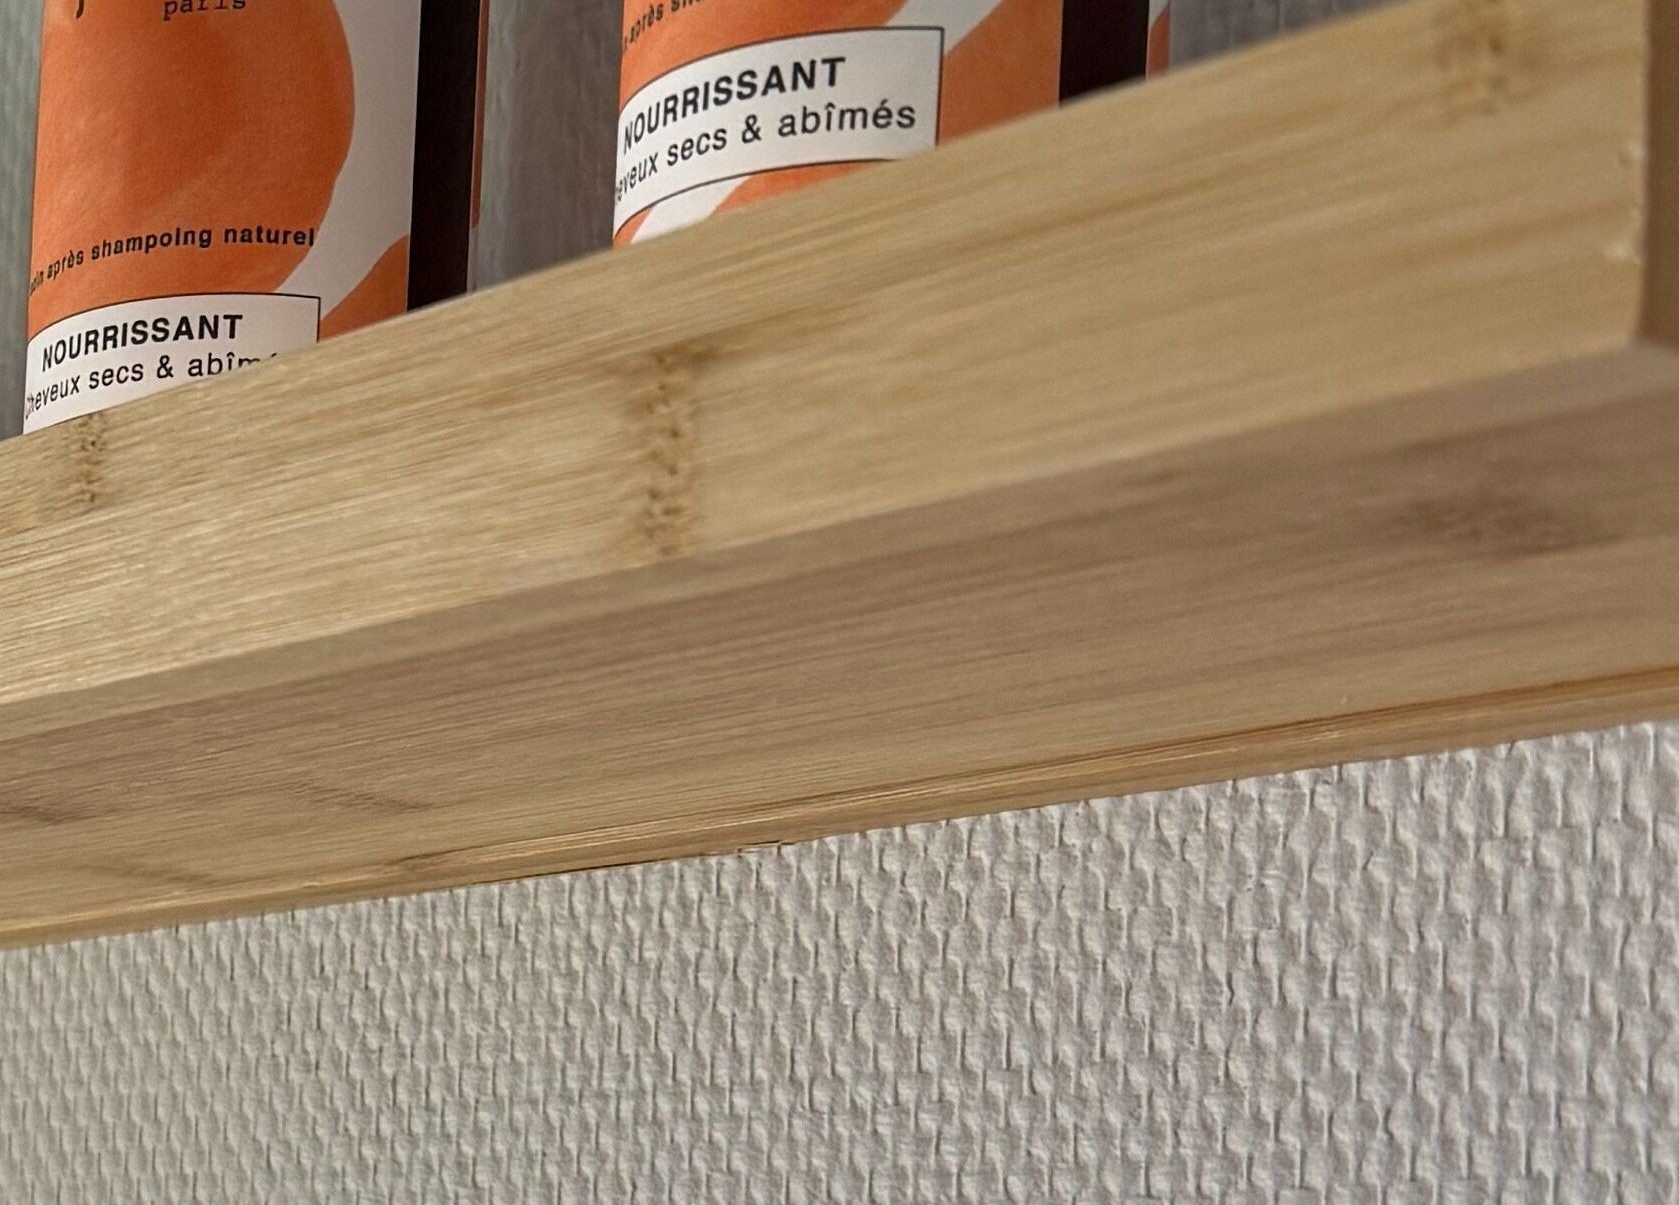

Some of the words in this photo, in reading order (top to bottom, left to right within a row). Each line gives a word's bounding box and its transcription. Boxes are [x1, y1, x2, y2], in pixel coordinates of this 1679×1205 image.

[623, 56, 846, 155] NOURRISSANT
[666, 127, 728, 167] secs
[741, 113, 763, 144] &
[777, 98, 916, 138] abîmés
[47, 250, 84, 283] après
[90, 227, 213, 261] shampoing
[223, 225, 316, 248] naturel
[41, 314, 244, 372] NOURRISSANT
[88, 362, 144, 389] secs
[156, 354, 175, 378] &
